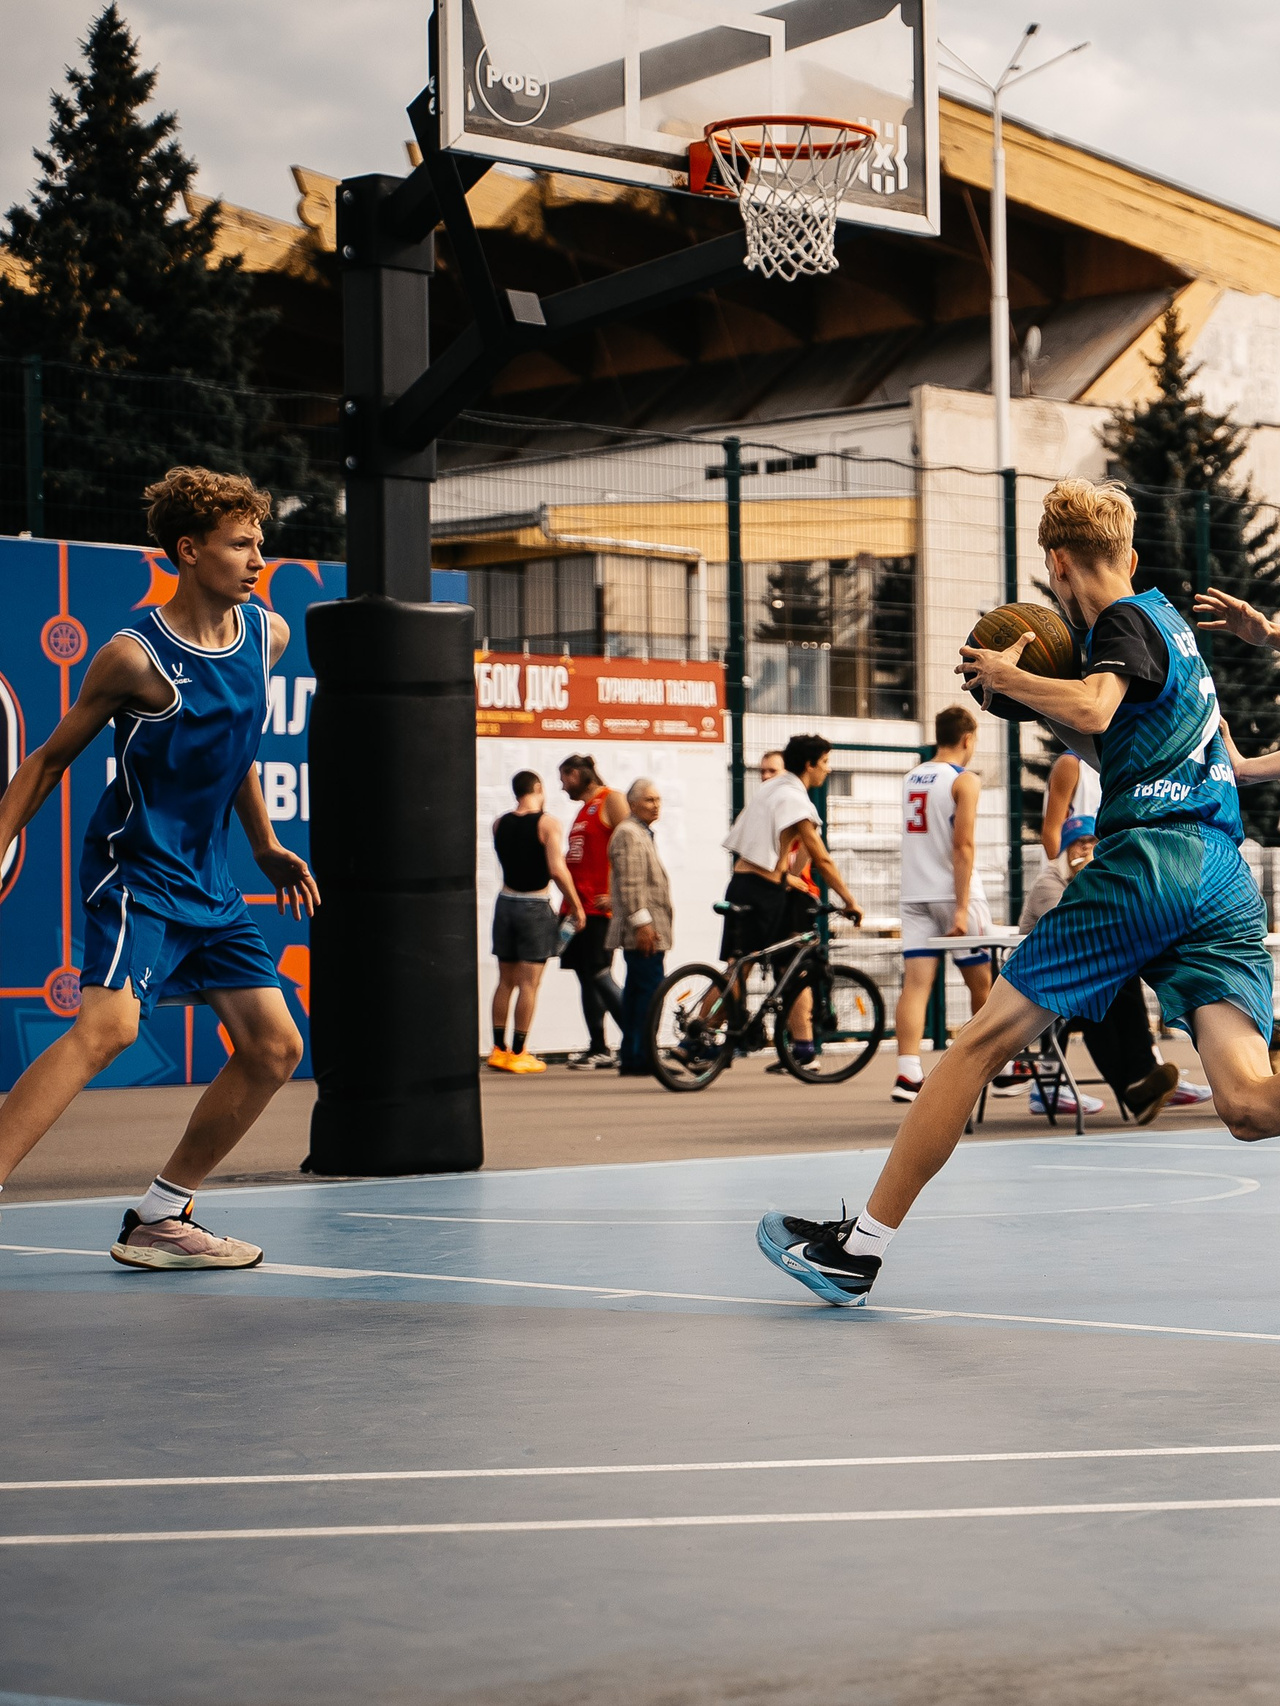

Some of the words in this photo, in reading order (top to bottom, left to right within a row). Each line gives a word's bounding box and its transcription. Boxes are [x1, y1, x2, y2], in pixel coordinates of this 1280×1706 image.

[486, 64, 541, 97] РФБ
[524, 664, 569, 713] ДКС
[906, 791, 929, 834] 3
